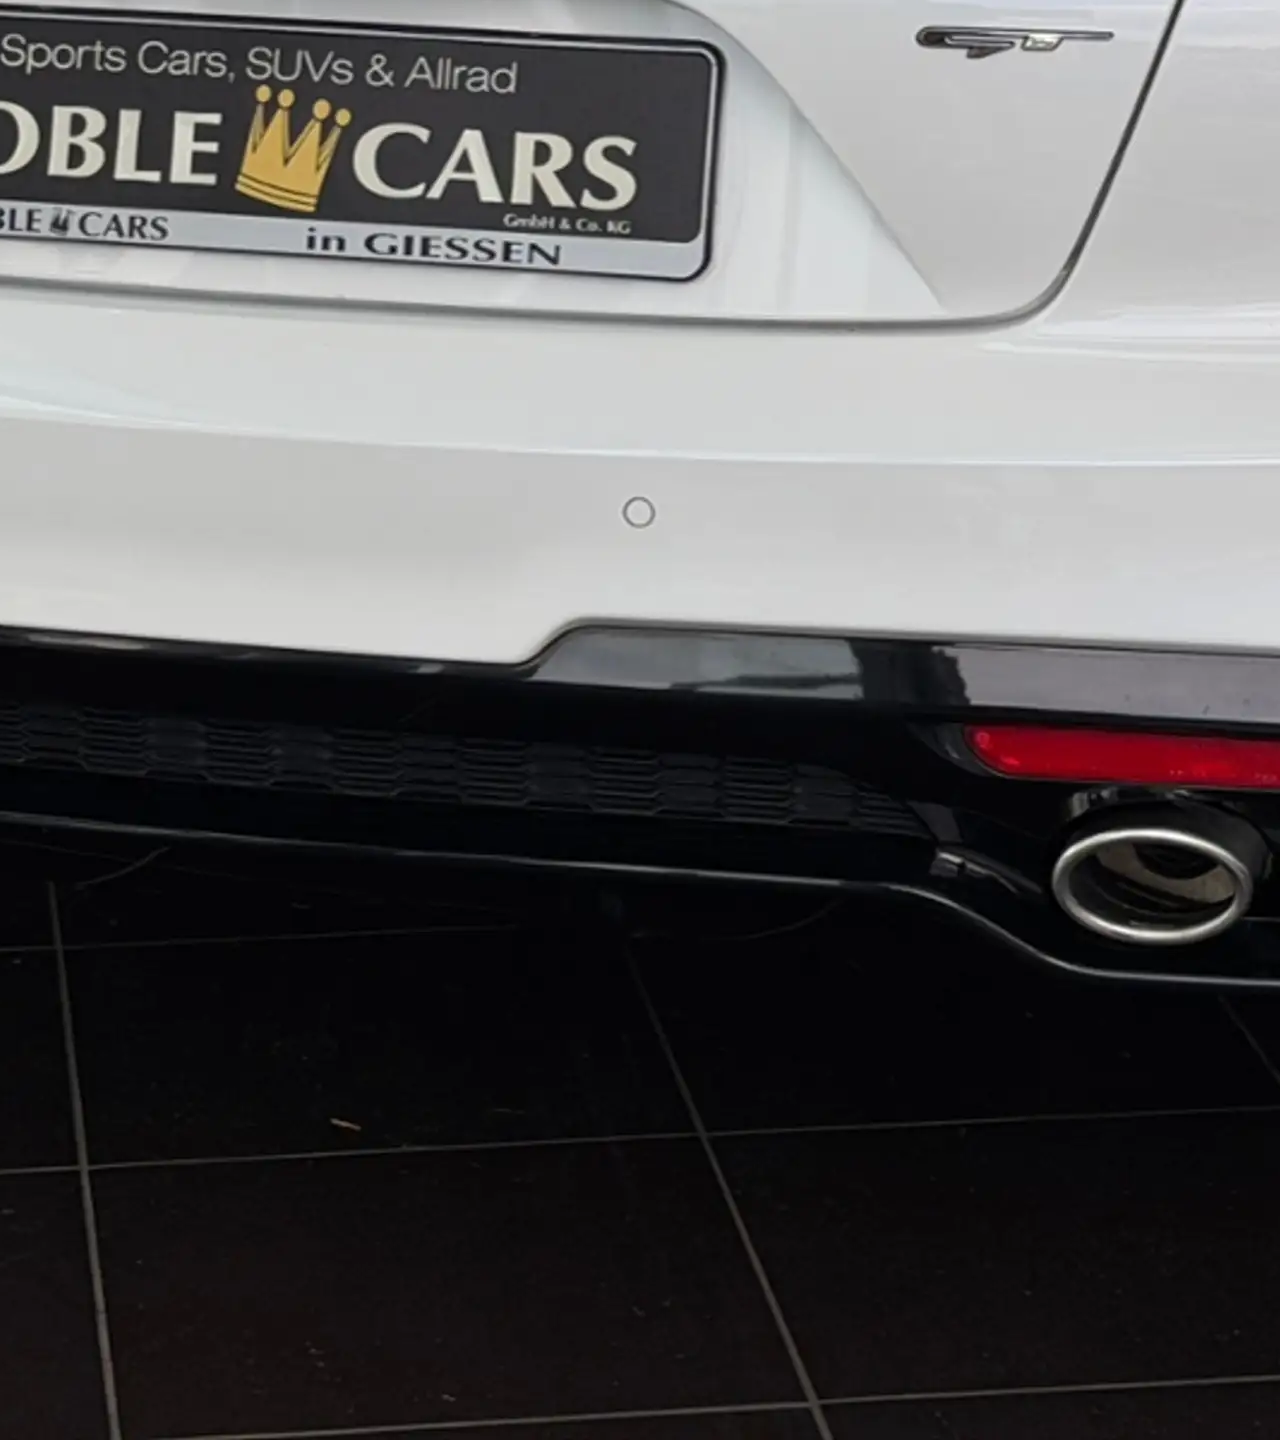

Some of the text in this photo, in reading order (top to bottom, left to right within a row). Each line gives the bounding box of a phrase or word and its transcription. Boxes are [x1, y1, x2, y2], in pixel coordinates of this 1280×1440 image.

[0, 33, 519, 94] Sports Cars, SUVs & Allrad
[352, 122, 639, 211] CARS
[77, 211, 170, 241] CARS
[305, 226, 562, 266] in GIESSEN
